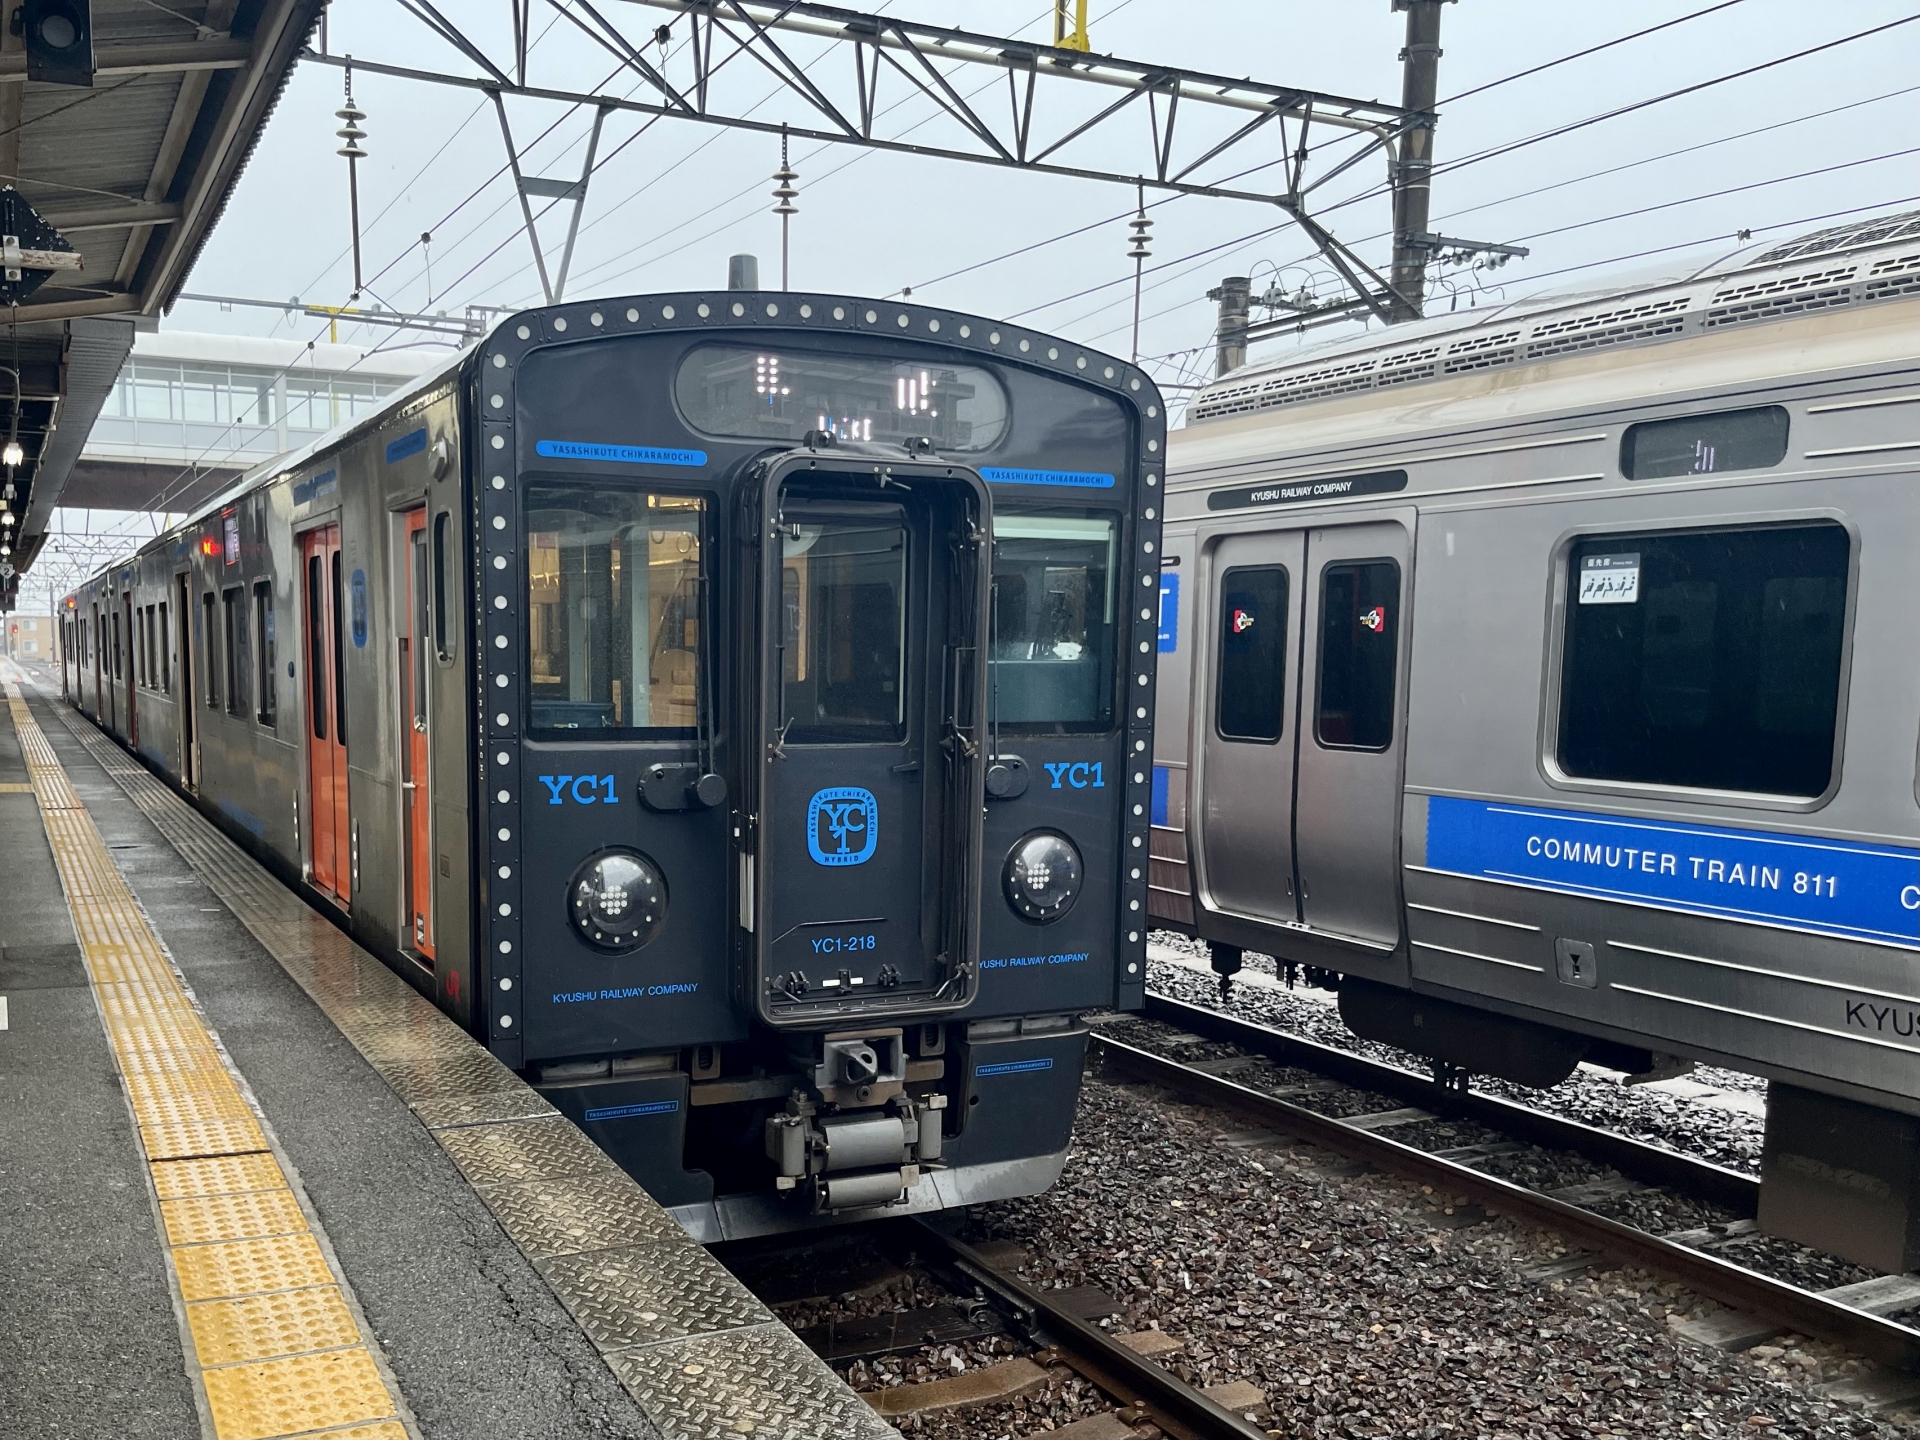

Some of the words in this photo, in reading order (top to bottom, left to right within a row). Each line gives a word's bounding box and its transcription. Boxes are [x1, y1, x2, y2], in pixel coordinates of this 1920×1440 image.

[552, 444, 618, 458] YASASHIKUTE
[621, 449, 693, 462] CHIKARAMOCHI
[990, 471, 1043, 482] YASASHIKUTE
[1045, 474, 1104, 485] CHIKARAMOCHI
[1250, 490, 1280, 502] KYUSHU
[1281, 486, 1312, 499] RAILWAY
[1313, 481, 1353, 495] COMPANY
[4, 567, 10, 576] 2
[1043, 761, 1105, 789] YC1
[538, 774, 619, 805] YC1
[810, 791, 839, 838] YASASHIKUTE
[841, 790, 876, 836] CHIKARAMOCHI
[824, 855, 859, 863] HYBRID
[1526, 835, 1677, 876] COMMUTER
[1688, 856, 1780, 890] TRAIN
[1792, 871, 1837, 898] 811
[812, 935, 876, 954] YC1-218
[1010, 955, 1046, 967] RAILWAY
[1048, 953, 1090, 964] COMPANY
[552, 991, 597, 1004] KYUSHU
[600, 987, 645, 999] RAILWAY
[647, 983, 698, 995] COMPANY
